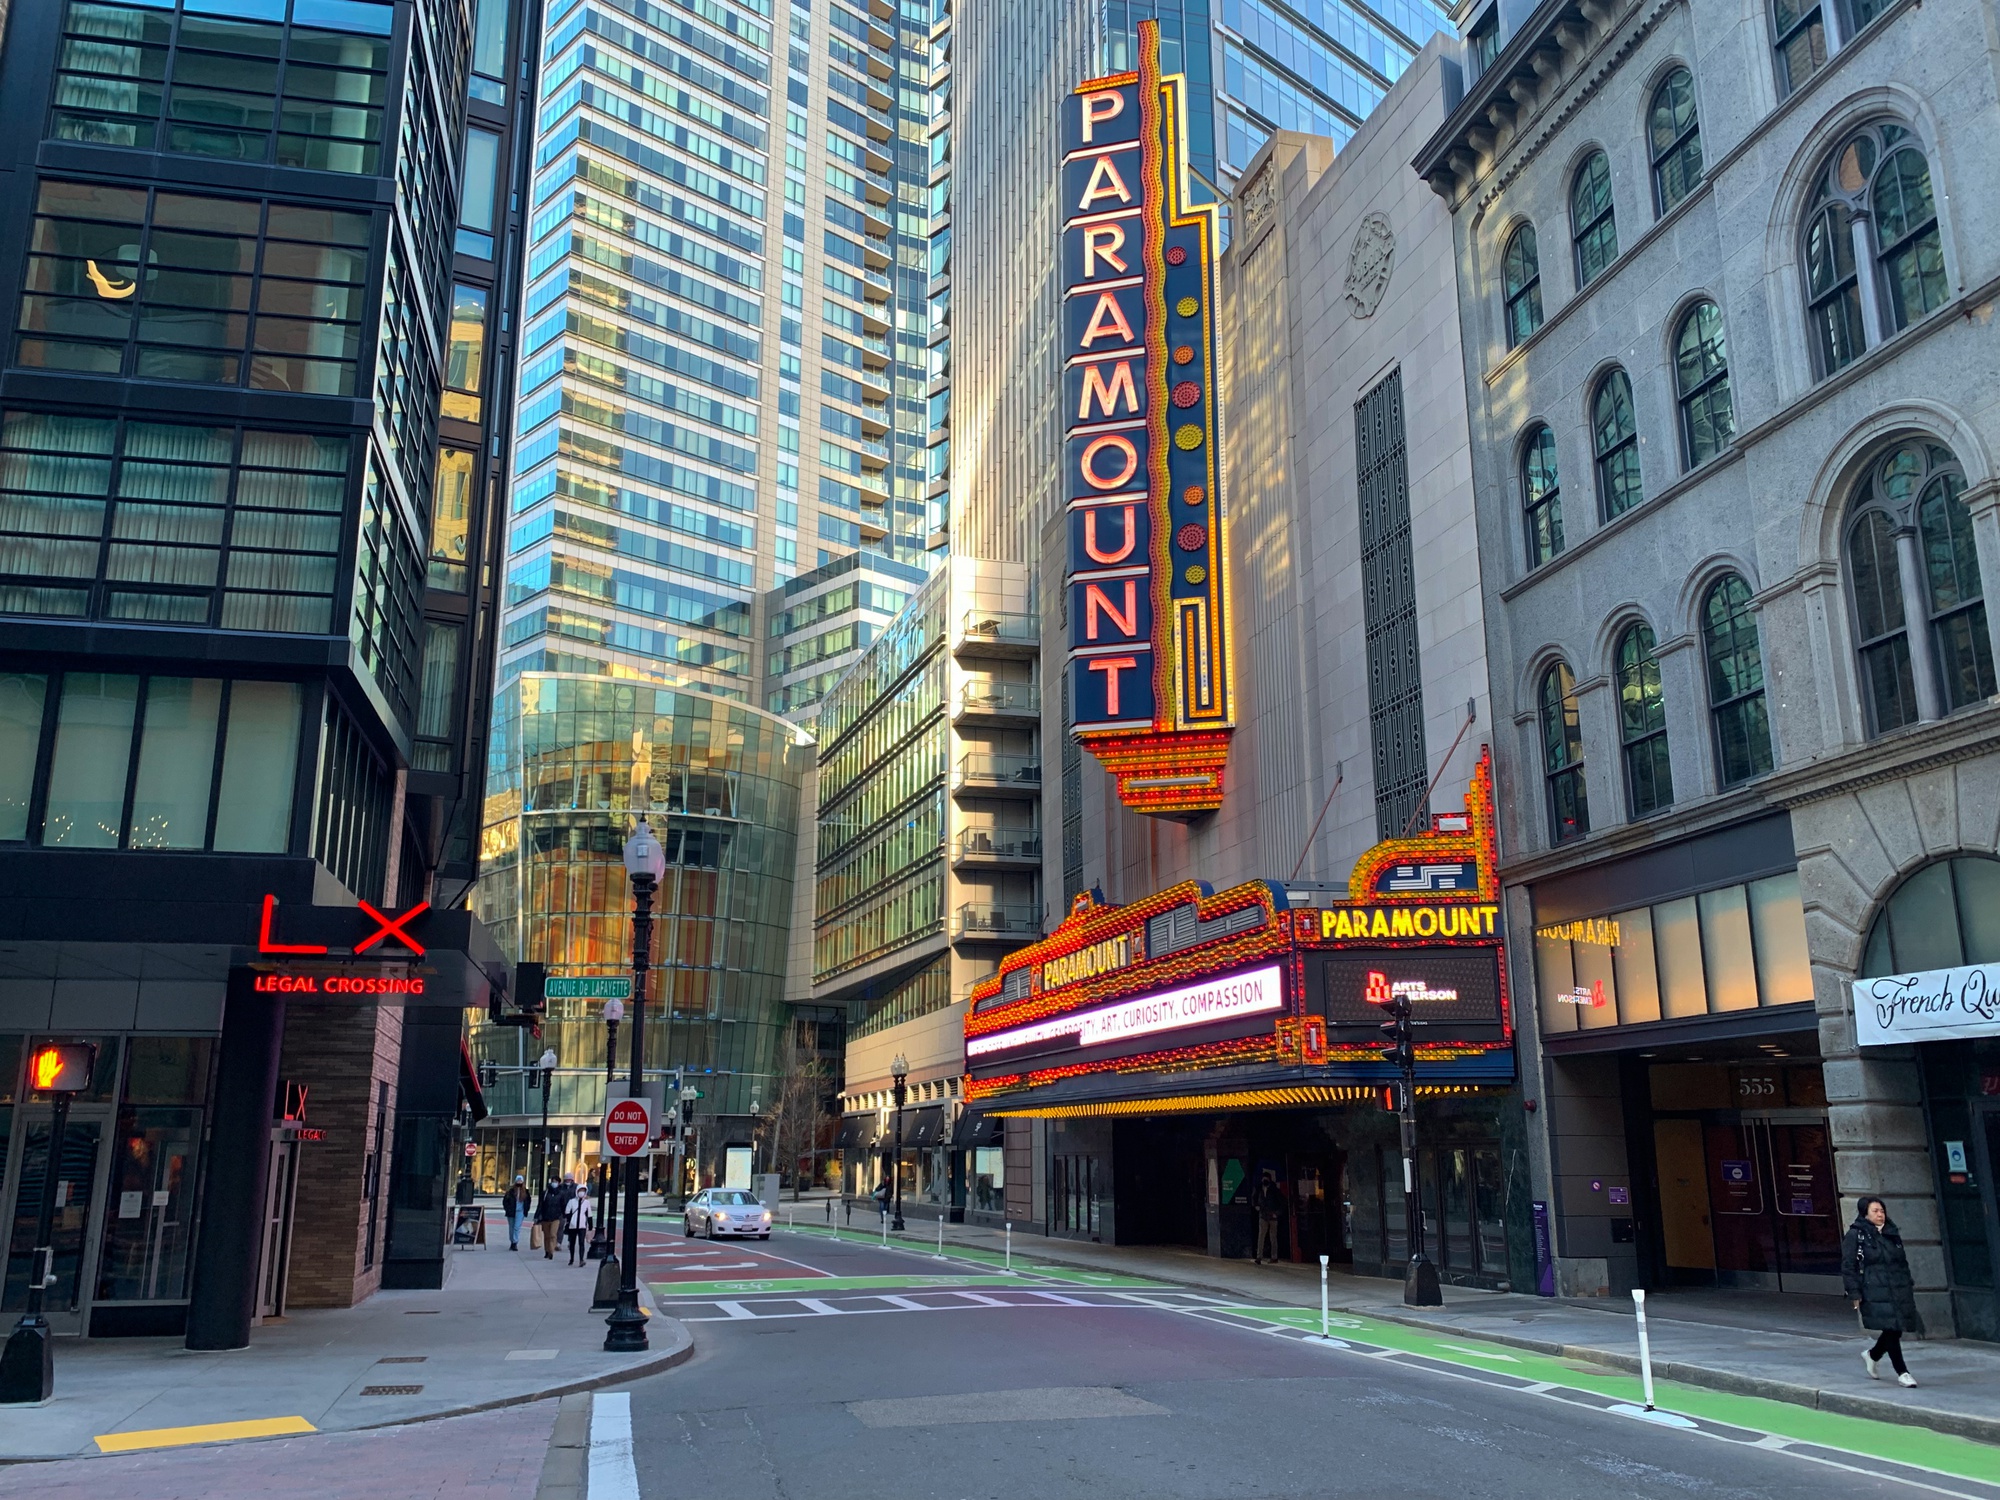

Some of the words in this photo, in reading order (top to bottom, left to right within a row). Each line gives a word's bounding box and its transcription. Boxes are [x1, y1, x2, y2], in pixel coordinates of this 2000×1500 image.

[1078, 90, 1140, 717] PARAMOUNT
[259, 894, 429, 955] LX
[1321, 906, 1499, 938] PARAMOUNT
[1044, 934, 1128, 991] PARAMOUNT
[255, 976, 318, 992] LEGAL
[324, 976, 423, 993] CROSSING
[549, 981, 576, 996] AVENUE
[580, 982, 588, 995] De
[592, 981, 628, 996] LAFAYETTE
[1182, 980, 1263, 1016] COMPASSION
[1392, 982, 1426, 991] ARTS
[1872, 974, 1954, 1029] French
[284, 1080, 309, 1121] LX
[1740, 1078, 1775, 1095] 555
[614, 1111, 625, 1120] DO
[627, 1111, 642, 1120] NOT
[614, 1136, 638, 1145] ENTER
